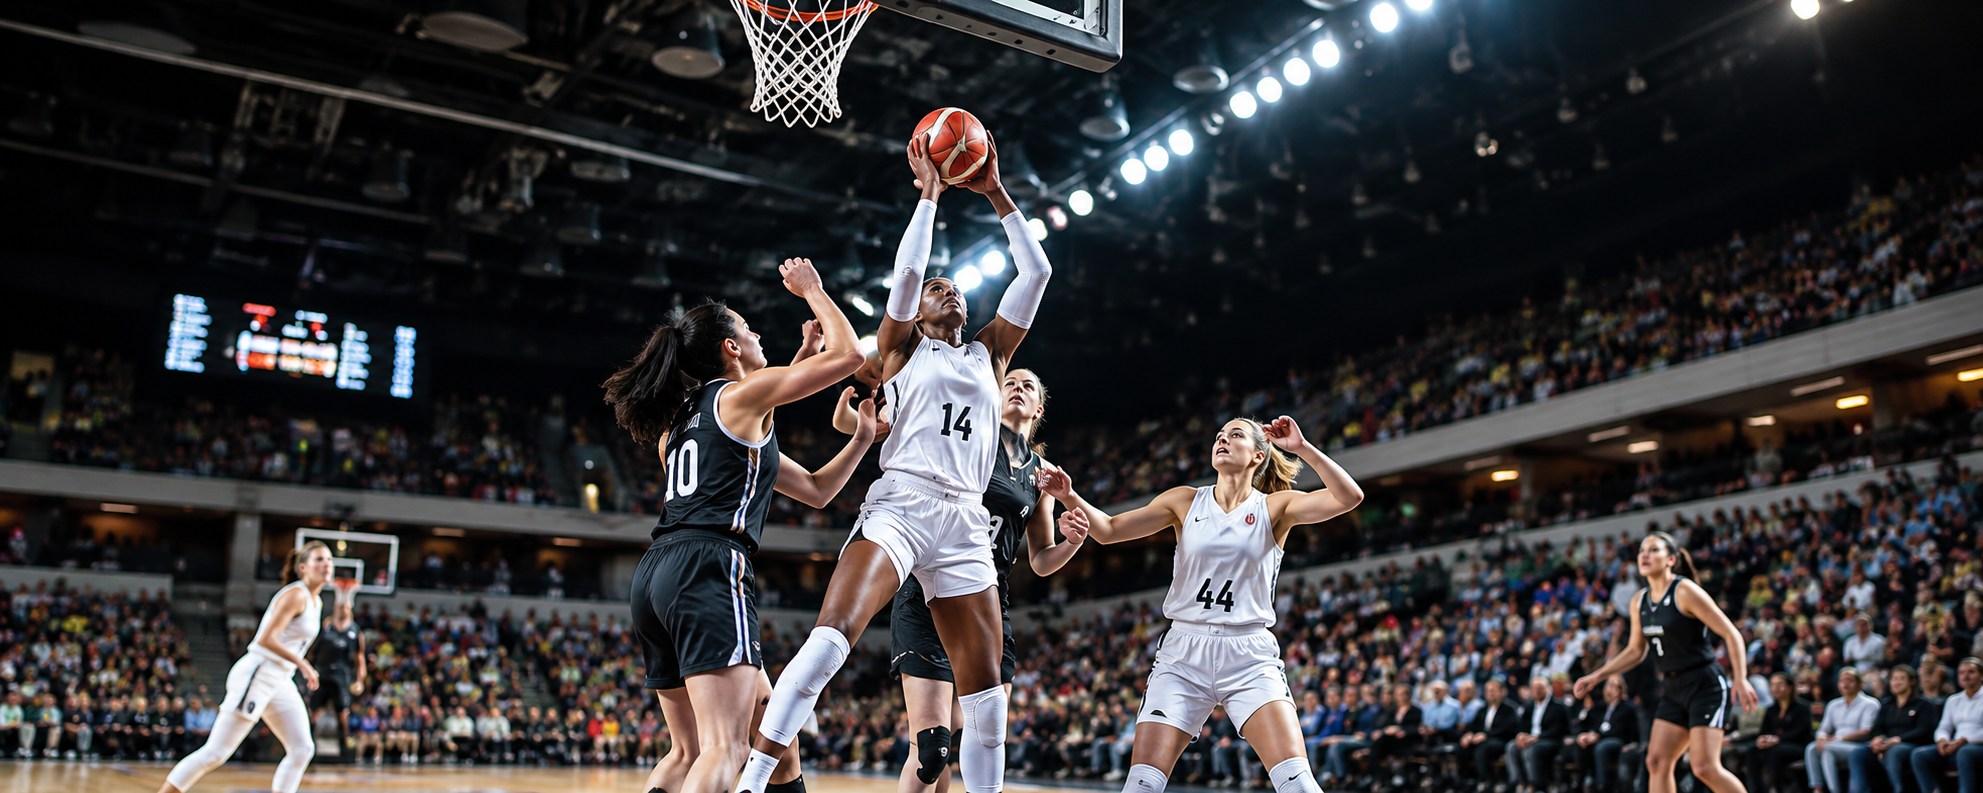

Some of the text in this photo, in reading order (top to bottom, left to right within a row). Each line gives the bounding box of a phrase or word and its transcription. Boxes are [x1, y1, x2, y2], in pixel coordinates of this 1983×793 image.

[941, 403, 972, 441] 14
[666, 439, 698, 502] 10
[1196, 578, 1233, 612] 44
